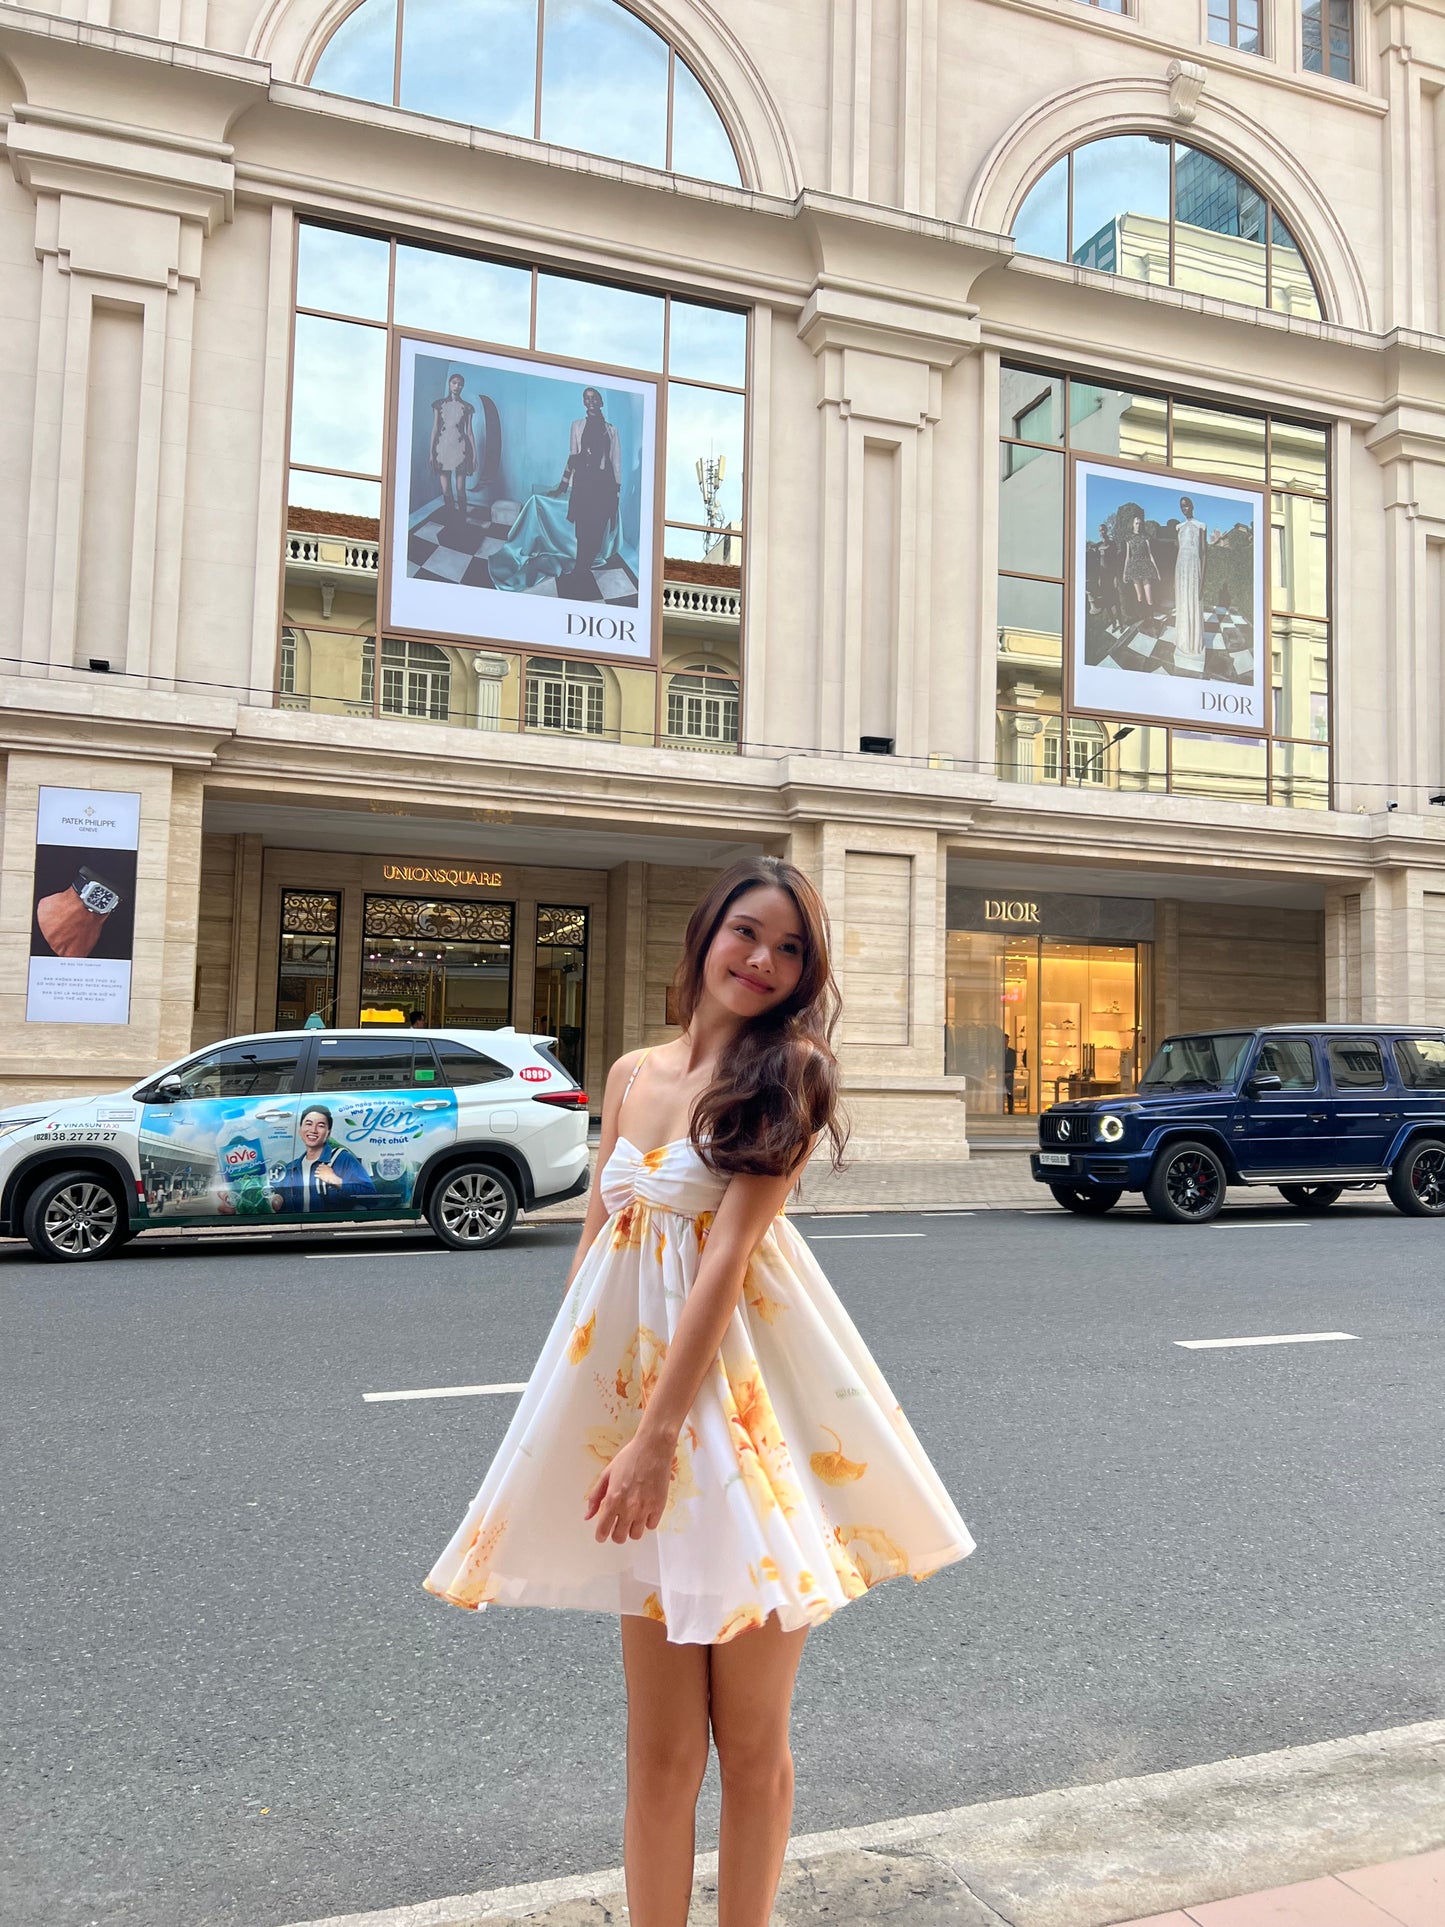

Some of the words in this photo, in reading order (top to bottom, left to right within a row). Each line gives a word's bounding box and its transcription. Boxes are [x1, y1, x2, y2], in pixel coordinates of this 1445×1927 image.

[565, 613, 637, 643] DIOR
[1200, 691, 1255, 716] DIOR
[61, 817, 84, 826] PATEK
[85, 819, 116, 828] PHILIPPE
[383, 865, 502, 886] UNIONSQUARE
[984, 900, 1040, 922] DIOR
[522, 1069, 549, 1080] 18994
[86, 1132, 100, 1141] 27
[103, 1132, 117, 1141] 27
